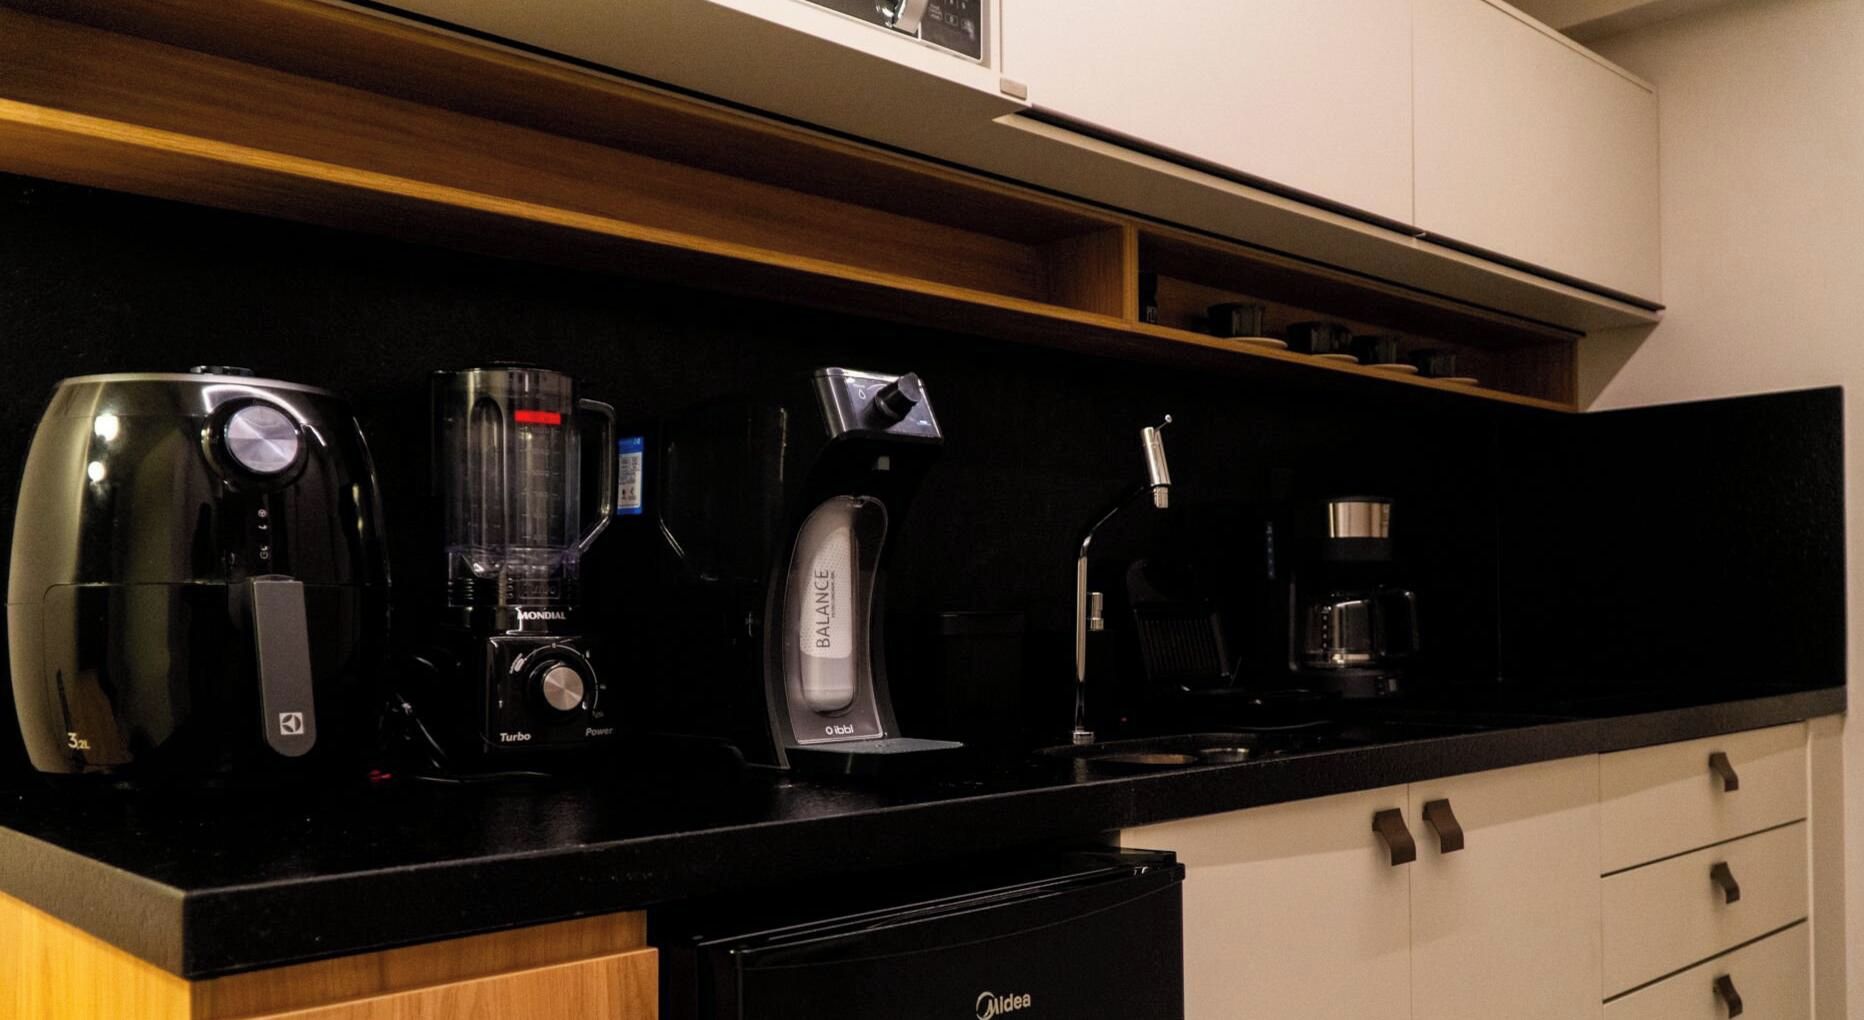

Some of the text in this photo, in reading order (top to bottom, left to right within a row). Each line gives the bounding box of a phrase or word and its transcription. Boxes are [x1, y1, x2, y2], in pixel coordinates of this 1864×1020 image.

[815, 569, 831, 648] BALANCE
[516, 611, 567, 620] MONDIAL
[585, 727, 613, 736] Power
[499, 732, 532, 742] Turbo
[976, 991, 1031, 1020] Midea
